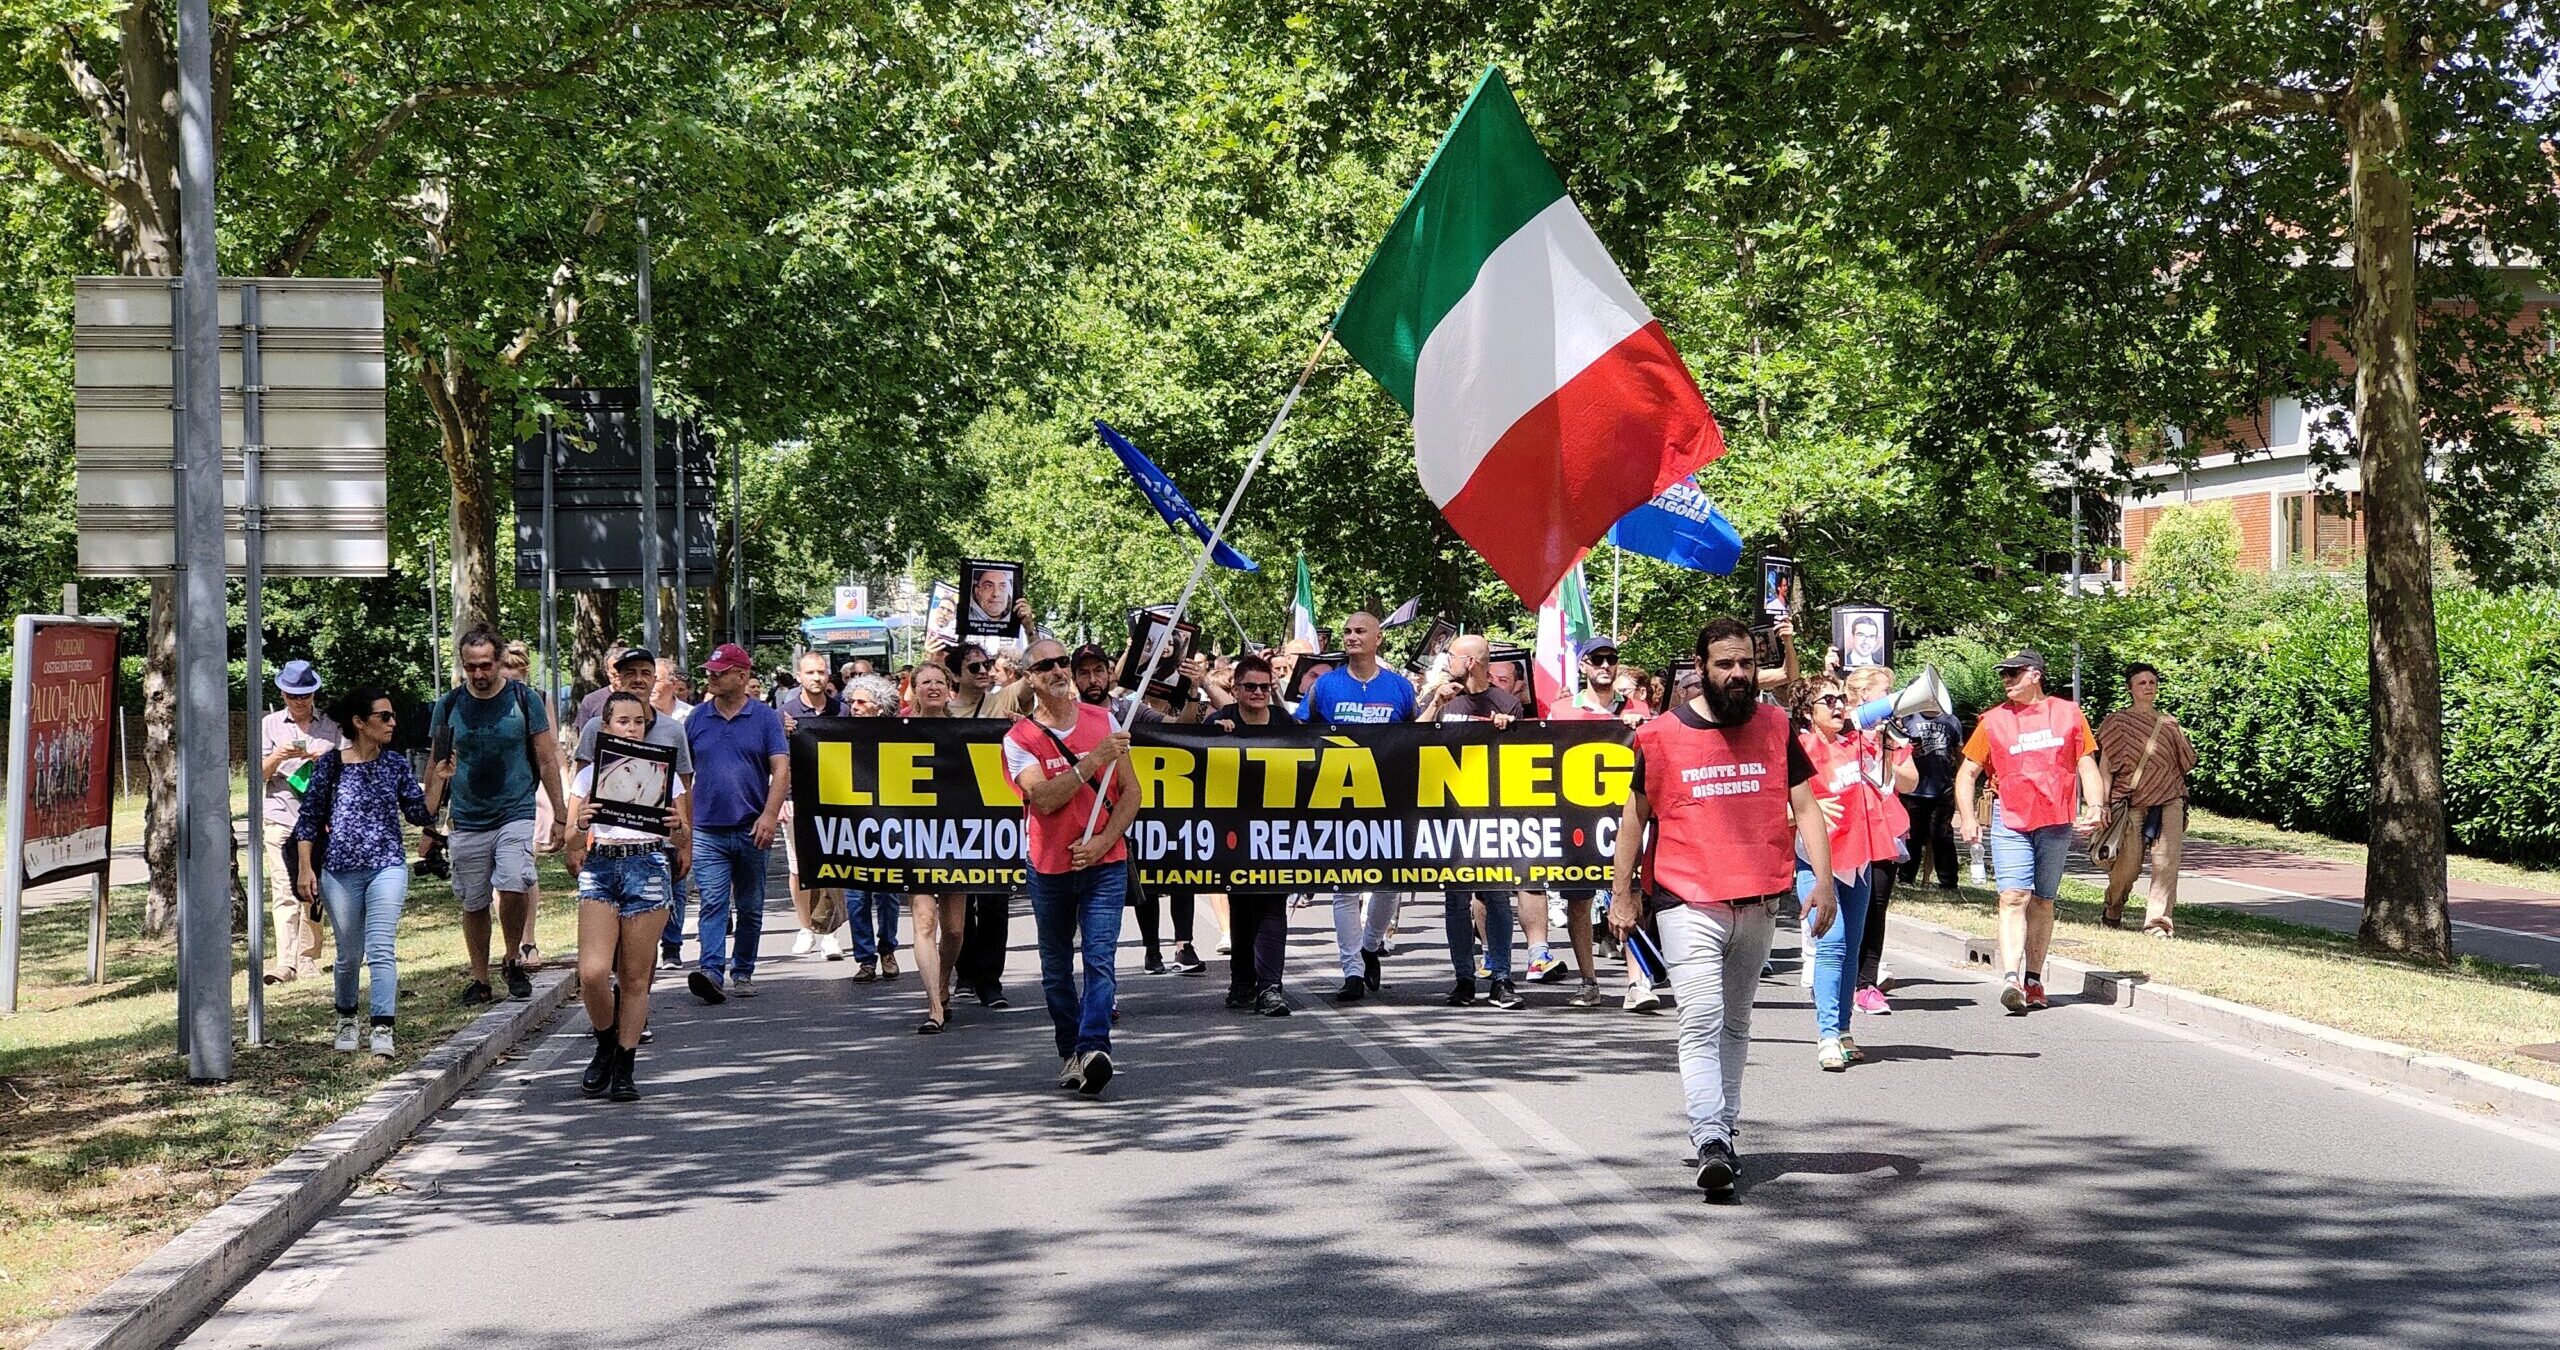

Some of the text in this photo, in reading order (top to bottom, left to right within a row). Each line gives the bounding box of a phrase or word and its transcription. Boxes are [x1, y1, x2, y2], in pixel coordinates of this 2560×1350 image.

[1648, 497, 1709, 524] AGONE
[842, 588, 857, 597] Q8
[68, 676, 105, 724] RIONI
[817, 736, 1635, 808] LE VRITÀ NEG
[1681, 763, 1766, 782] FRONTE DEL
[1692, 780, 1760, 798] DISSENSO
[1249, 819, 1403, 860] REAZIONI
[1414, 817, 1562, 858] AVVERSE
[817, 863, 904, 885] AVETE
[1140, 869, 1221, 884] LIANI:
[1230, 868, 1383, 885] CHIEDIAMO
[1393, 866, 1522, 885] INDAGINI,
